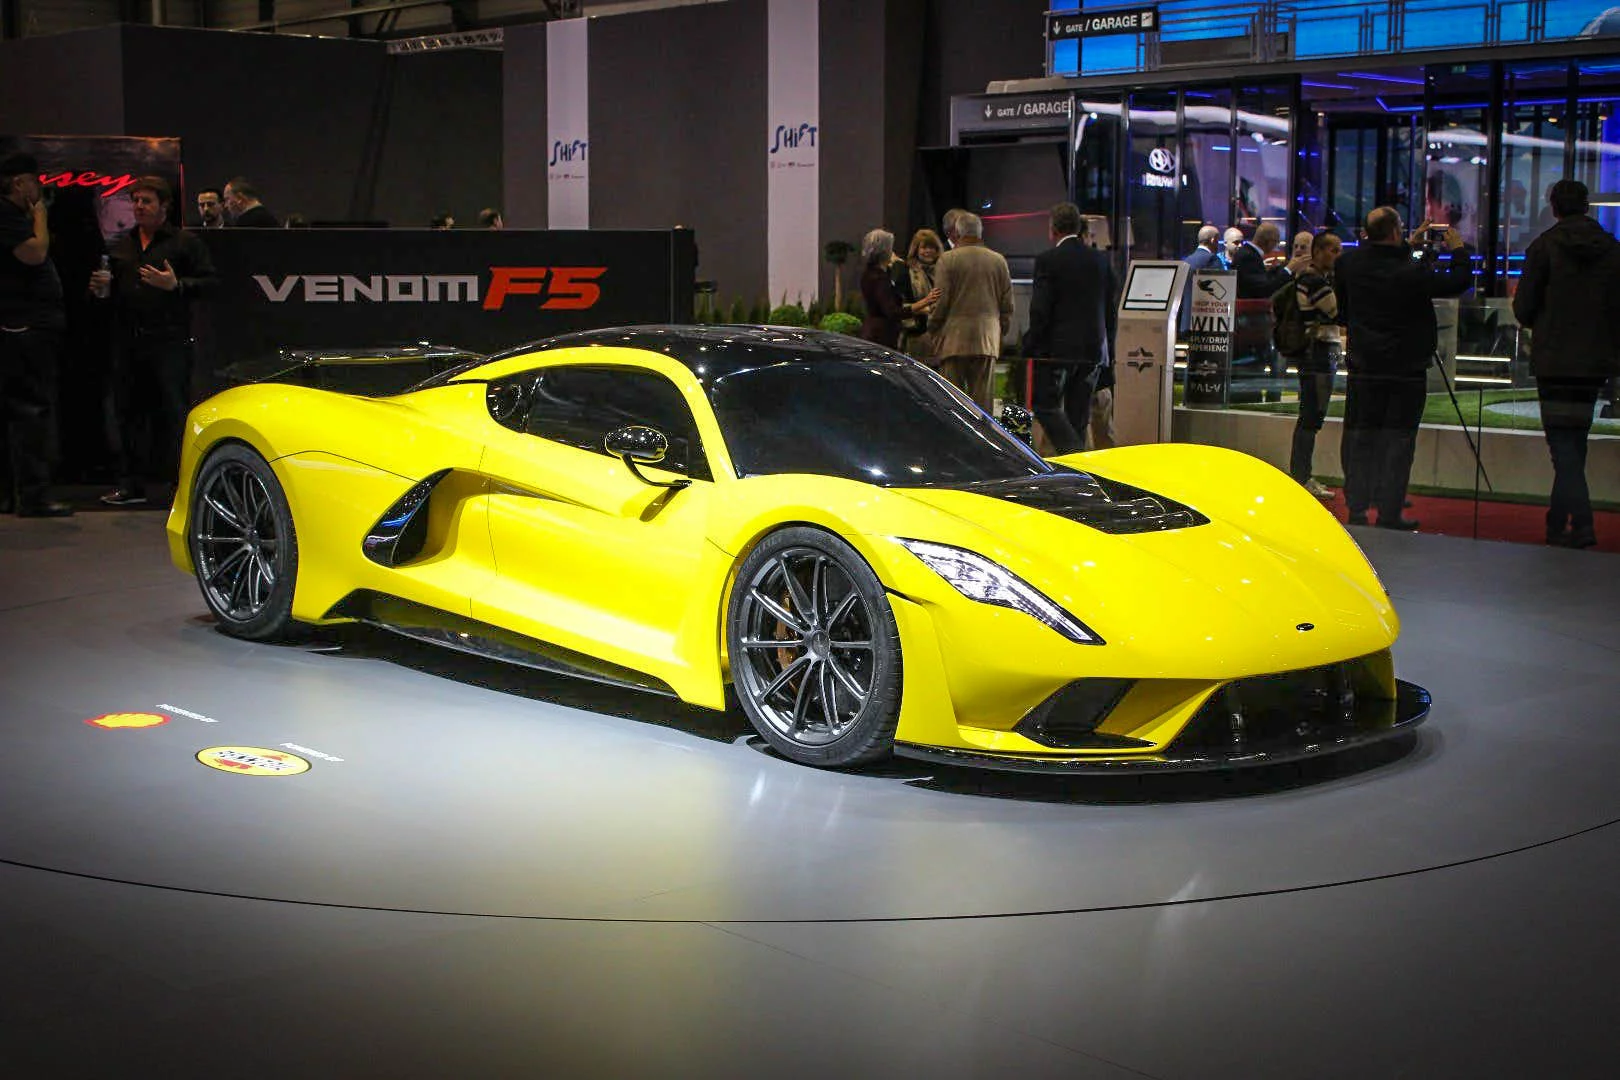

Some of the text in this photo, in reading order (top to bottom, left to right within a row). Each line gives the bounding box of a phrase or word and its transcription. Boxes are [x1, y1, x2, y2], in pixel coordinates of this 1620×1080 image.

[1065, 23, 1083, 33] GATE
[1092, 15, 1138, 31] GARAGE
[997, 107, 1014, 117] GATE
[1023, 101, 1067, 115] GARAGE
[252, 266, 607, 310] VENOM F5
[1192, 315, 1231, 332] WIN
